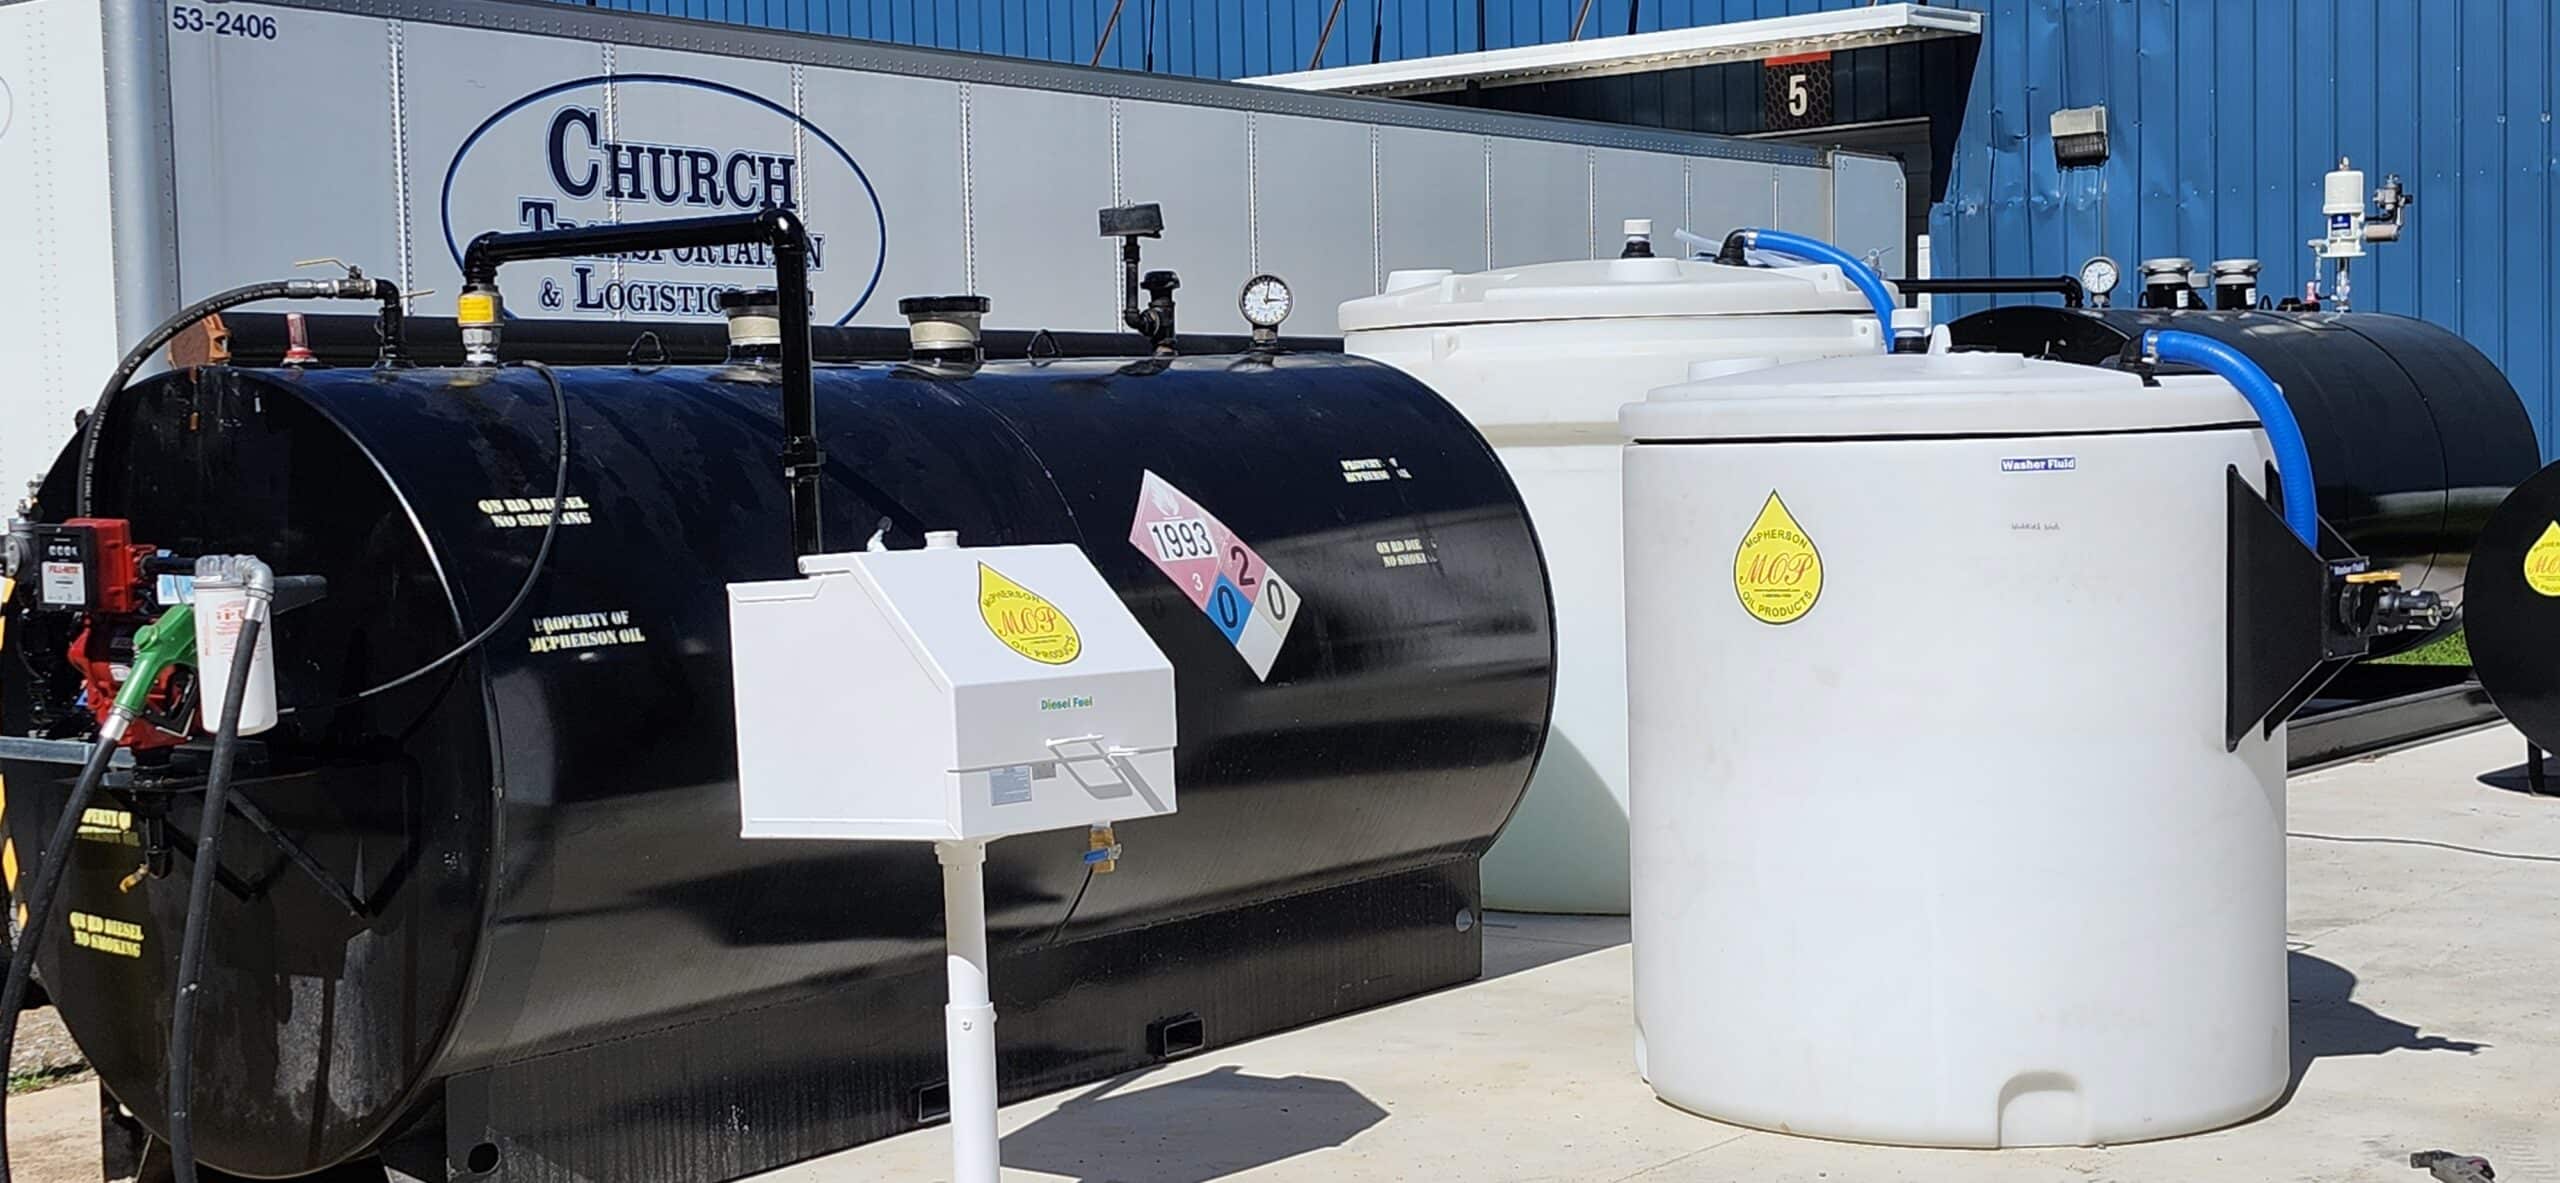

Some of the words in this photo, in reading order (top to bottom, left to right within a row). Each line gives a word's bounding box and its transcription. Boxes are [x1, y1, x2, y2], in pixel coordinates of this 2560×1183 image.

[172, 6, 277, 40] 53-2406
[1789, 74, 1807, 116] 5
[548, 107, 798, 210] CHURCH
[540, 279, 561, 309] &
[573, 266, 738, 315] LOGISTIC
[2001, 460, 2046, 470] Washer
[2048, 459, 2074, 469] Fluid
[1152, 521, 1213, 559] 1993
[1192, 572, 1204, 592] 3
[1230, 545, 1255, 586] 2
[1739, 552, 1815, 586] MOP
[1216, 585, 1239, 629] 0
[1266, 578, 1286, 622] 0
[618, 627, 646, 643] OIL
[1040, 698, 1071, 711] Diesel
[1073, 696, 1093, 708] Fuel
